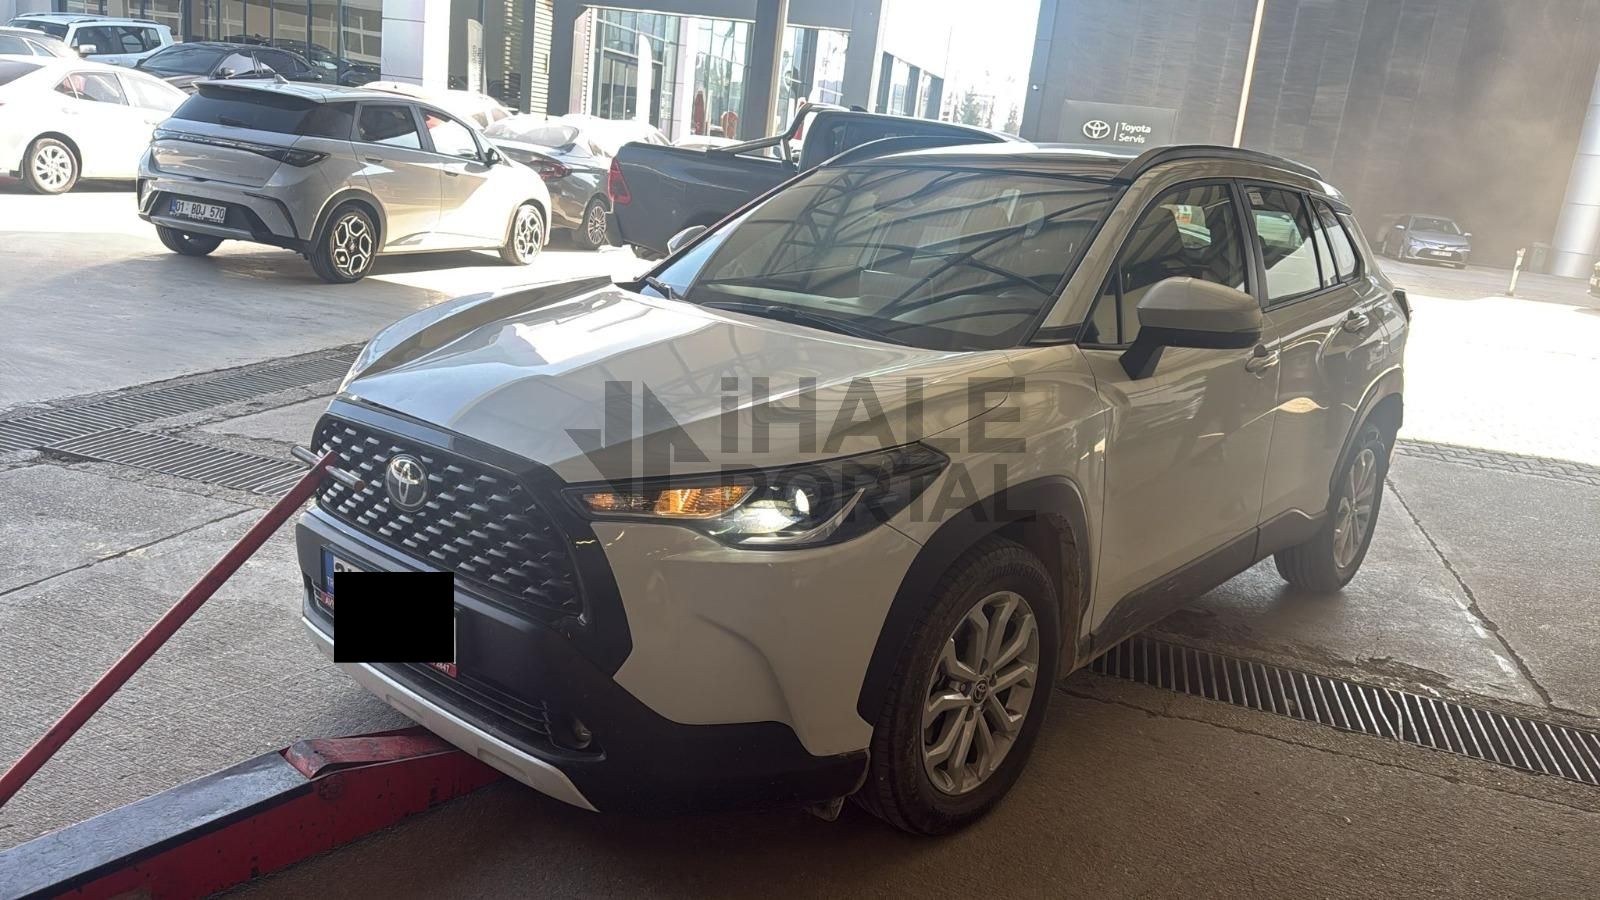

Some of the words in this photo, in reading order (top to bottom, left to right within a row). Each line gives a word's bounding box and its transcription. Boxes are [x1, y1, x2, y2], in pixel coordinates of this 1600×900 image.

[1121, 122, 1151, 133] Toyota
[1119, 133, 1146, 144] Servis
[176, 201, 185, 212] 01
[210, 206, 225, 219] 570
